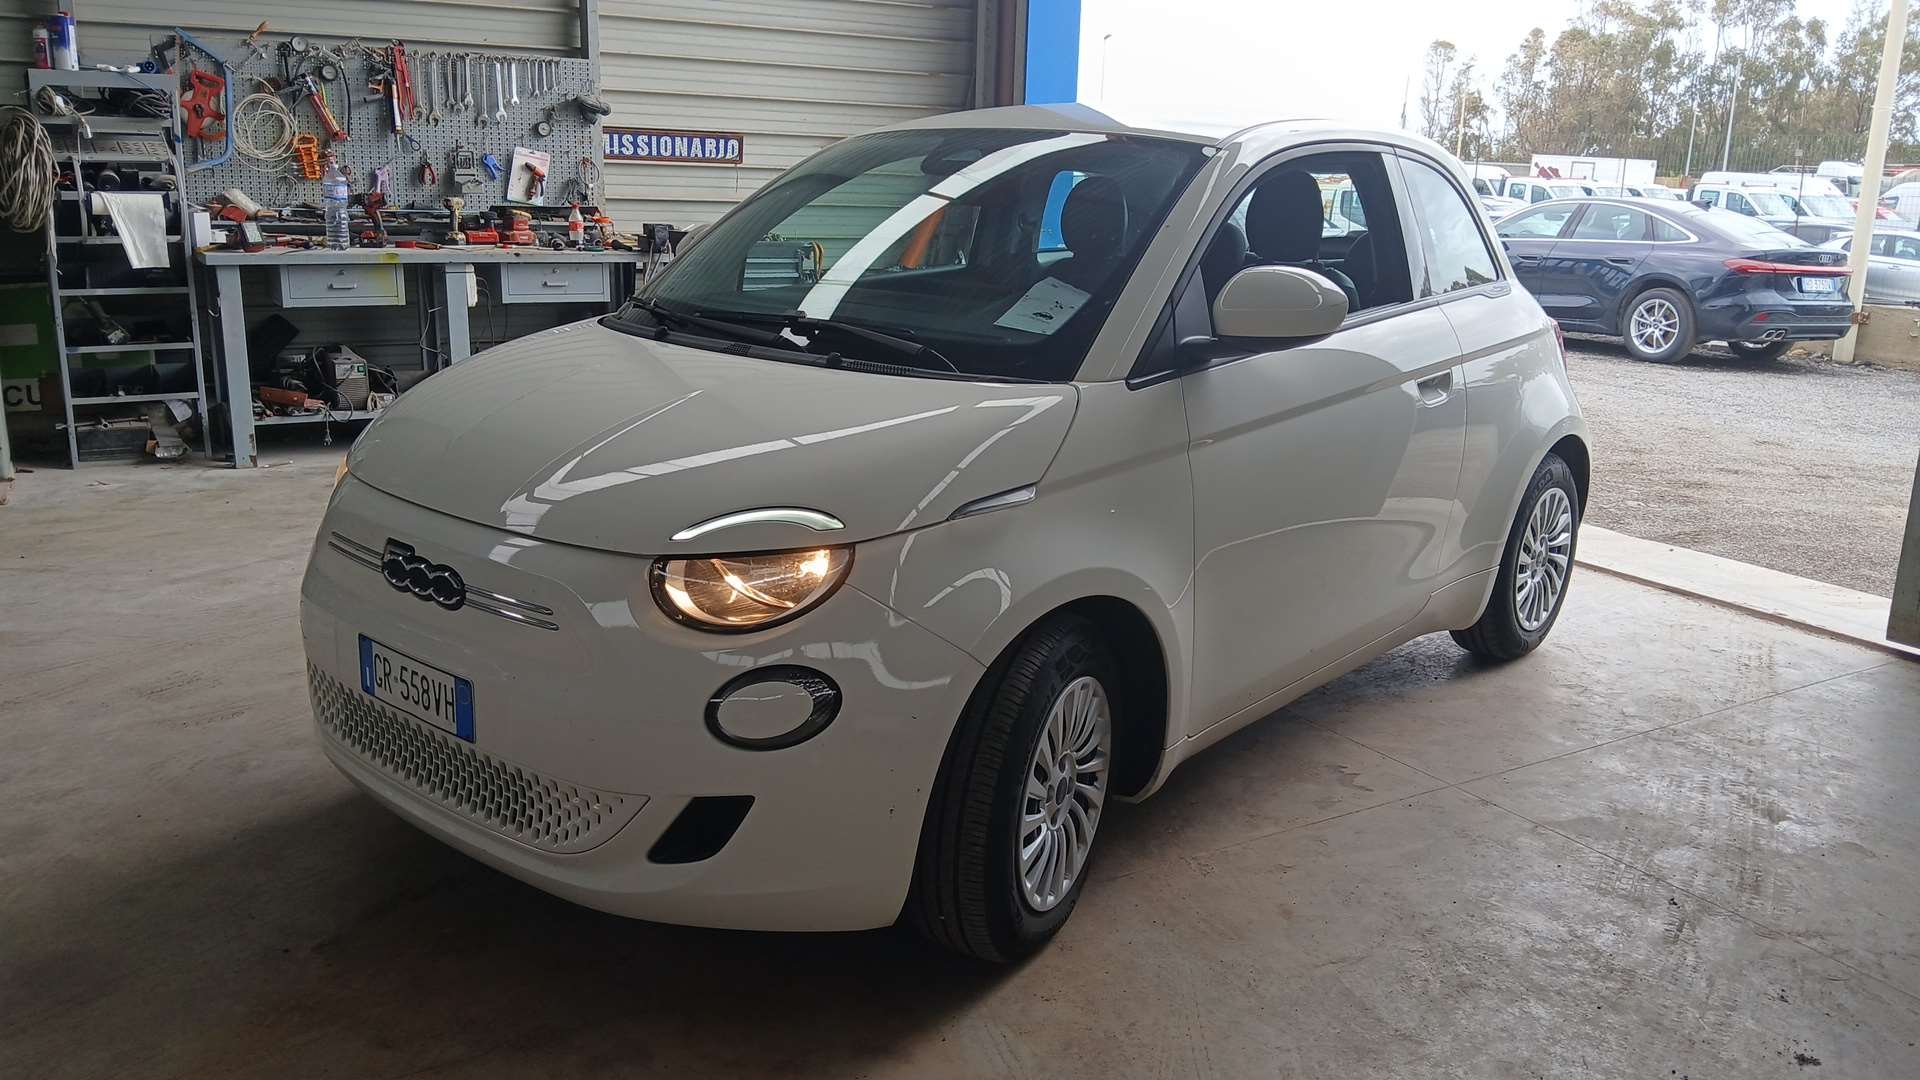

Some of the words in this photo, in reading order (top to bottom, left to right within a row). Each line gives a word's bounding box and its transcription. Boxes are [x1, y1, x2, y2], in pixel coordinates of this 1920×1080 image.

[382, 537, 466, 611] 500
[374, 653, 392, 695] GR
[400, 665, 455, 723] 558VH
